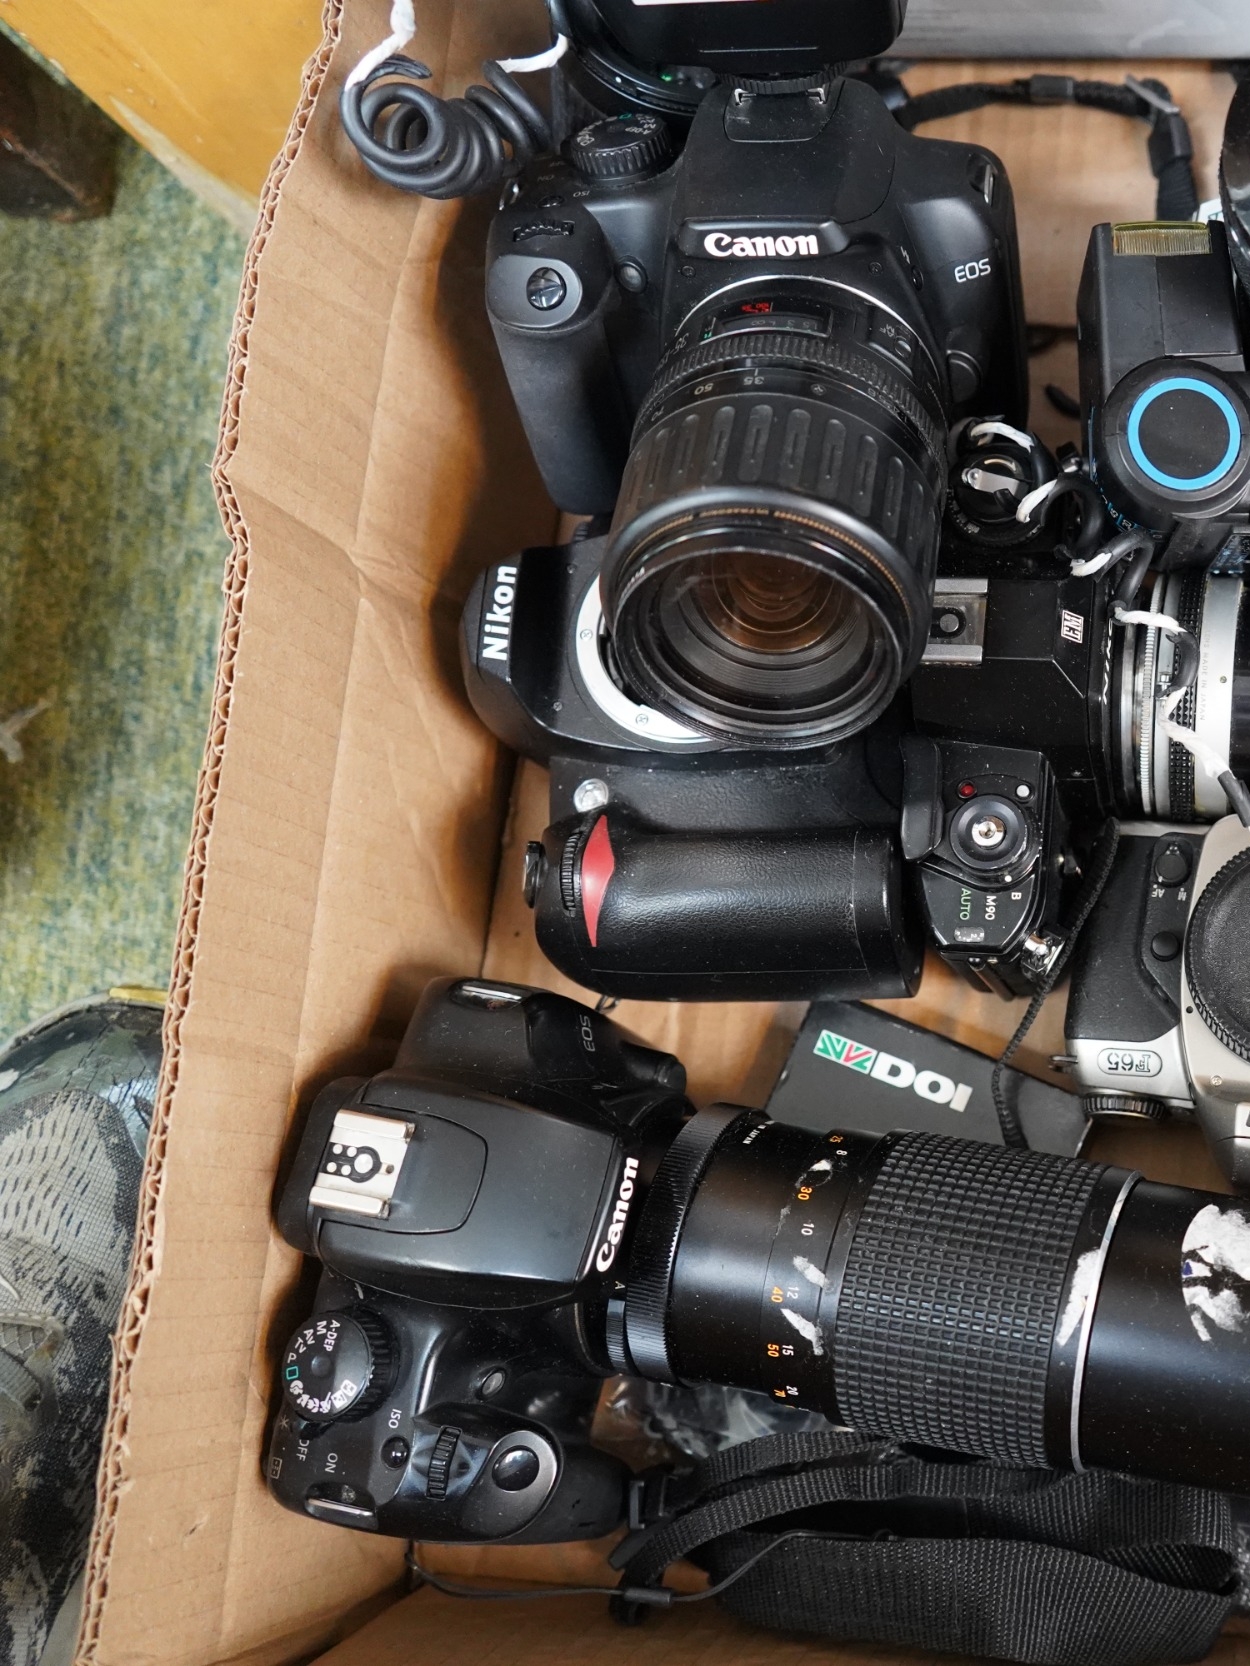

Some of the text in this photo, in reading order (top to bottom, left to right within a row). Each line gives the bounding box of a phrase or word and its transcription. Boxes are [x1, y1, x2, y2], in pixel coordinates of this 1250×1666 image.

[703, 232, 820, 258] Canon
[953, 257, 992, 284] EOS
[482, 565, 518, 661] Nikon
[1061, 609, 1084, 643] EM
[959, 887, 972, 921] AUTO
[1010, 892, 1022, 900] B
[984, 895, 998, 921] M90
[579, 1014, 596, 1052] EOS
[870, 1051, 974, 1113] DOI
[797, 1185, 813, 1201] 30
[595, 1156, 640, 1273] Canon
[800, 1221, 815, 1236] 10
[770, 1285, 784, 1304] 40
[786, 1286, 799, 1300] 12
[316, 1320, 328, 1335] M
[322, 1319, 341, 1352] A-DEP
[287, 1352, 297, 1364] P
[767, 1343, 780, 1358] 50
[782, 1344, 795, 1357] 15
[387, 1408, 402, 1429] ISO
[324, 1452, 338, 1474] ON
